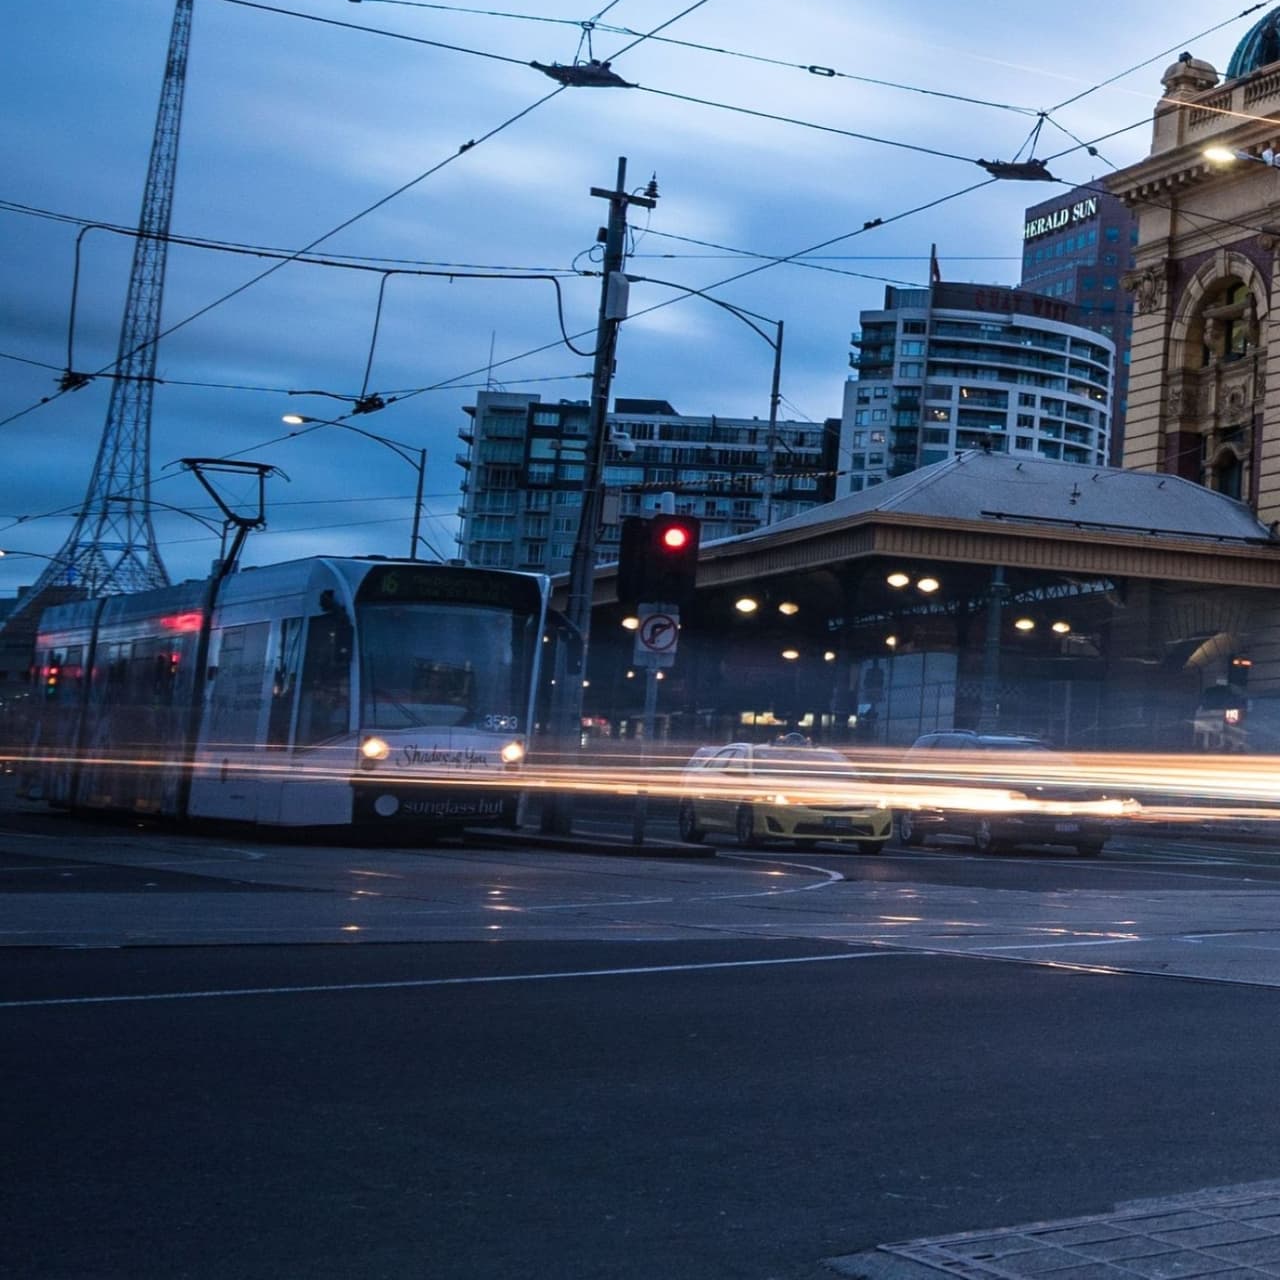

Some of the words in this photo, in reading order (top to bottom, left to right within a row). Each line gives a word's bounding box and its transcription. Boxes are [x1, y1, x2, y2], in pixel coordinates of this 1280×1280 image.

[1024, 208, 1069, 238] HERALD
[1072, 197, 1097, 221] SUN
[395, 744, 449, 767] Shades
[404, 799, 475, 816] sunglass
[480, 799, 503, 813] hut
